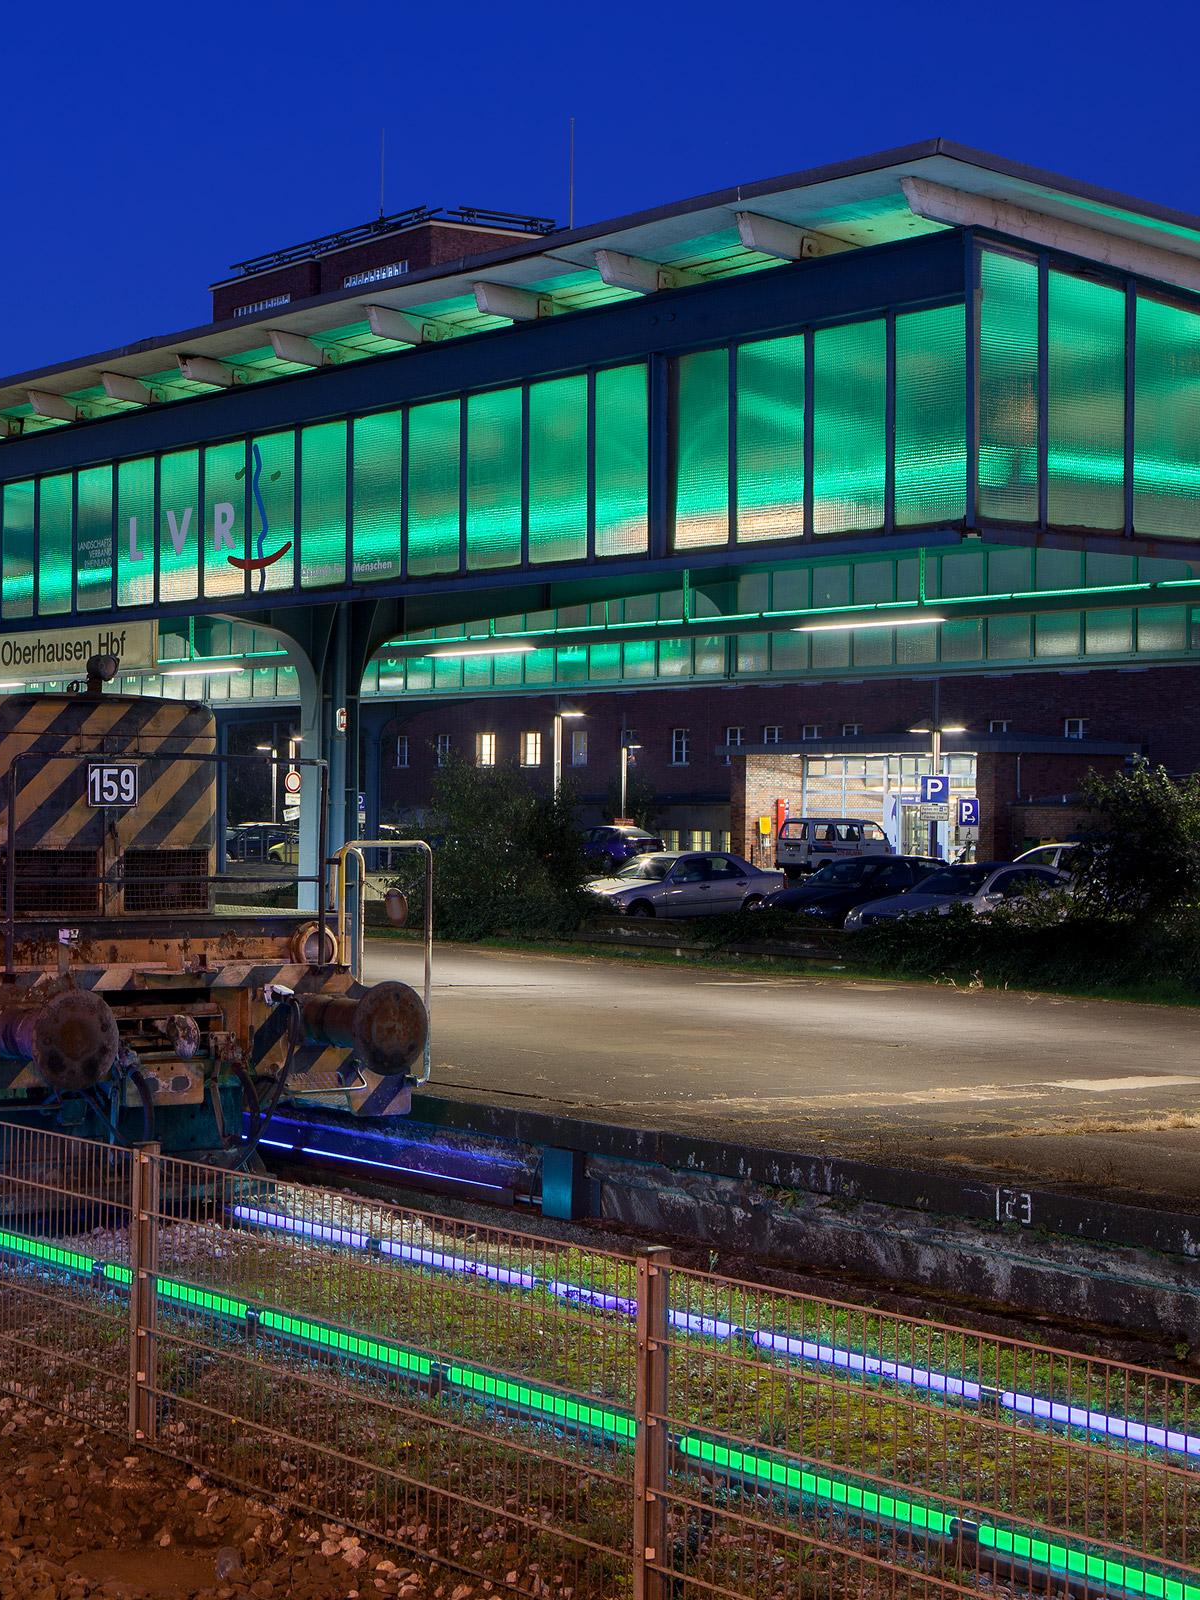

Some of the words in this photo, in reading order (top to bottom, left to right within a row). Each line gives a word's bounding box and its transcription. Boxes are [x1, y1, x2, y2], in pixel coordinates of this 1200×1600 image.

[129, 502, 237, 562] LVR
[84, 557, 112, 569] RHEINLAND
[89, 547, 112, 559] VERBAND
[353, 559, 392, 573] Menschen
[1, 635, 92, 667] Oberhausen
[98, 630, 127, 657] Hbf
[90, 768, 135, 802] 159
[926, 778, 943, 800] P
[961, 802, 974, 823] P
